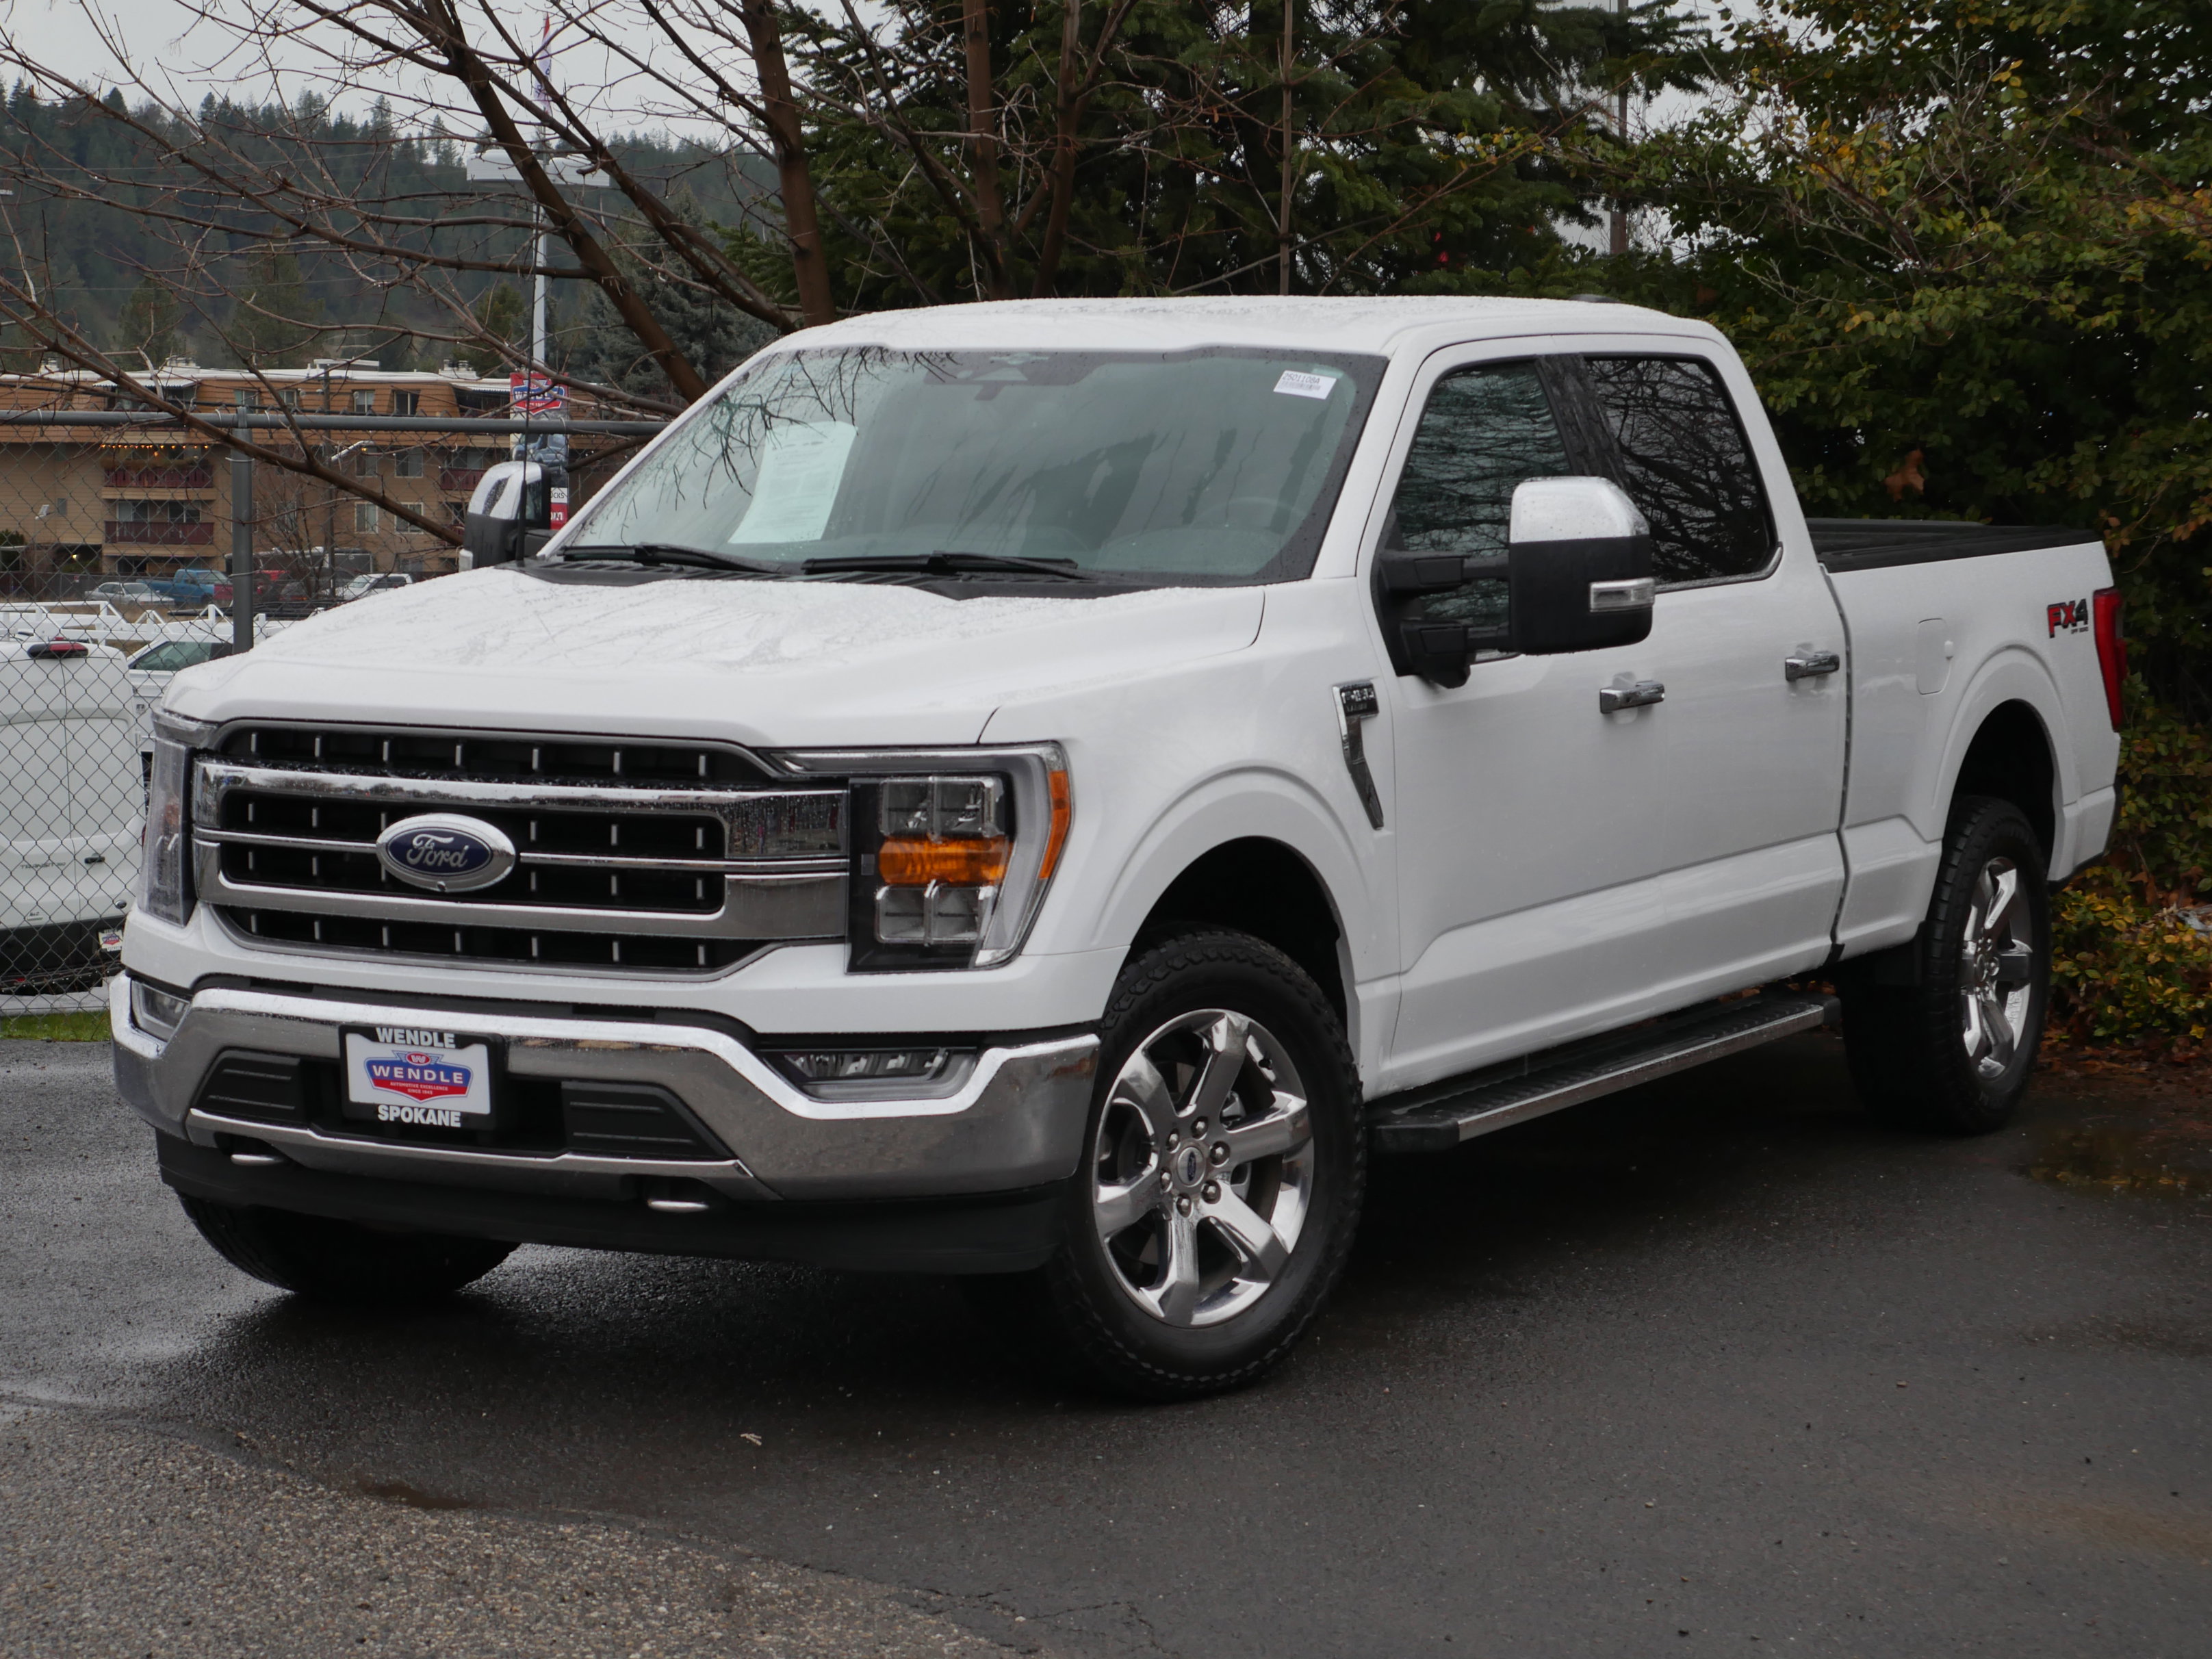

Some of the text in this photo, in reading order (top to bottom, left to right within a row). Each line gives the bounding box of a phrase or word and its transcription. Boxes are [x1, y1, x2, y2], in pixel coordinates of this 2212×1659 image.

[2047, 598, 2088, 639] FX4
[406, 834, 470, 868] Ford
[376, 1027, 456, 1049] WENDLE
[372, 1065, 464, 1084] WENDLE
[377, 1104, 461, 1128] SPOKANE
